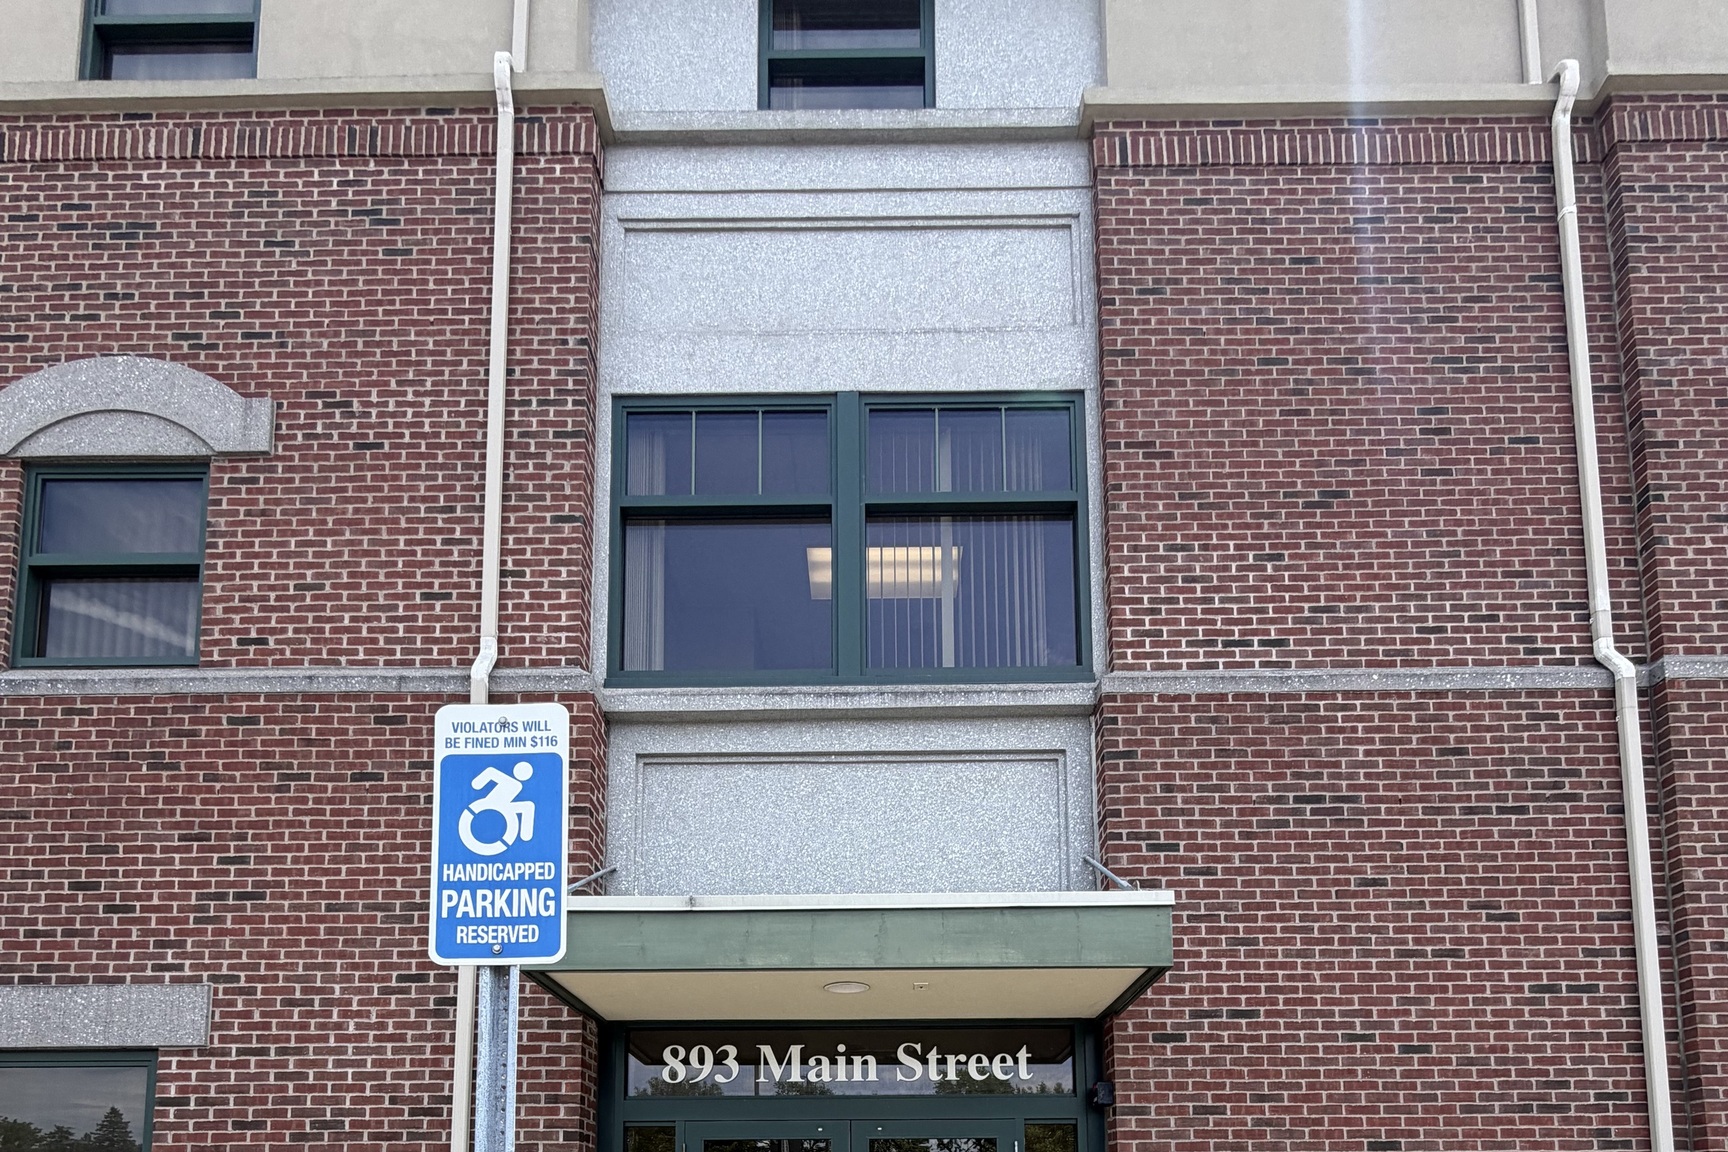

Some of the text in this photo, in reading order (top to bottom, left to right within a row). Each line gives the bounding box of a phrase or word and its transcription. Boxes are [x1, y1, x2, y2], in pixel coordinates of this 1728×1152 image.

[451, 720, 552, 734] VIOLATORS WILL
[444, 735, 558, 749] BE FINED MIN $116
[442, 862, 555, 882] HANDICAPPED
[441, 887, 556, 919] PARKING
[456, 924, 539, 944] RESERVED
[661, 1042, 1034, 1084] 893 Main Street
